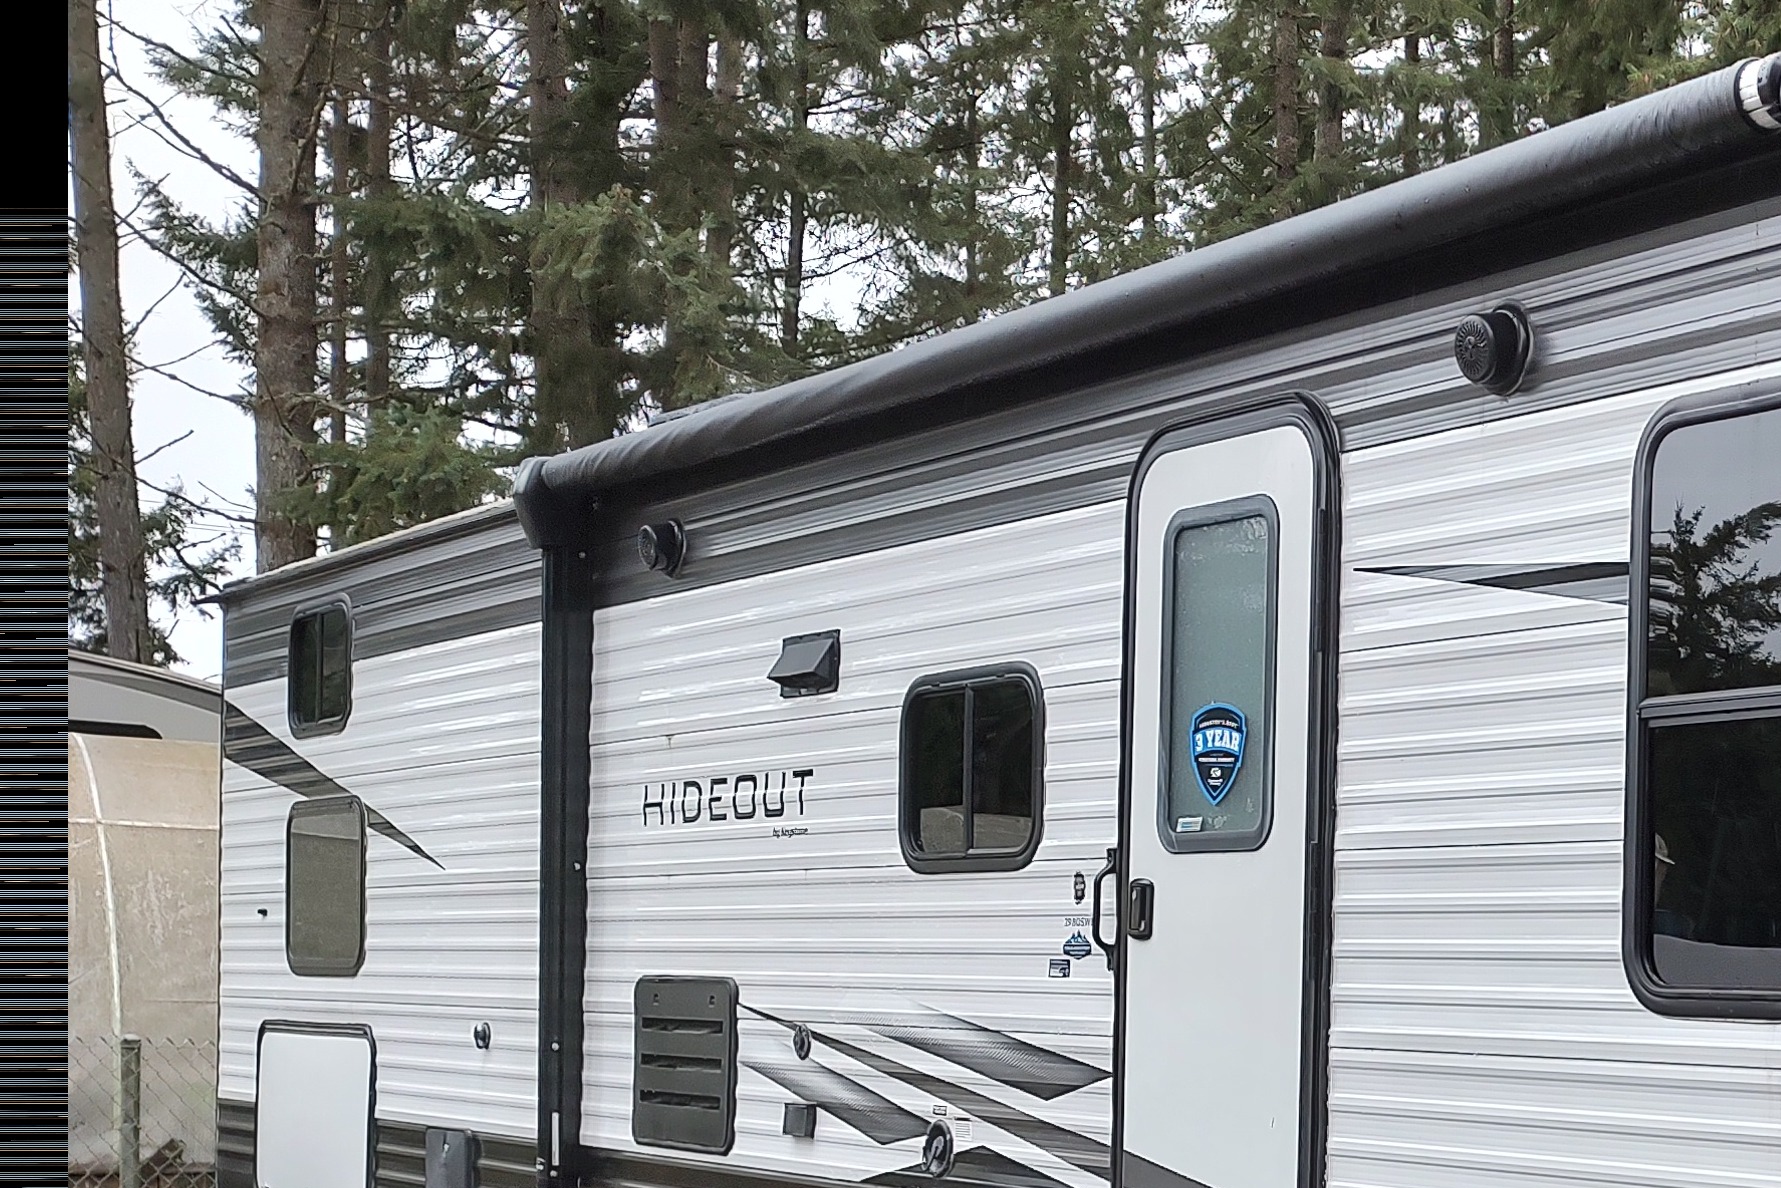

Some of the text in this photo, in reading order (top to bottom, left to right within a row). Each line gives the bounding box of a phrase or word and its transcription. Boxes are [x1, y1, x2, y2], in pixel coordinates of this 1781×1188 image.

[1194, 729, 1240, 752] 3 YEAR
[642, 768, 814, 827] HIDEOUT
